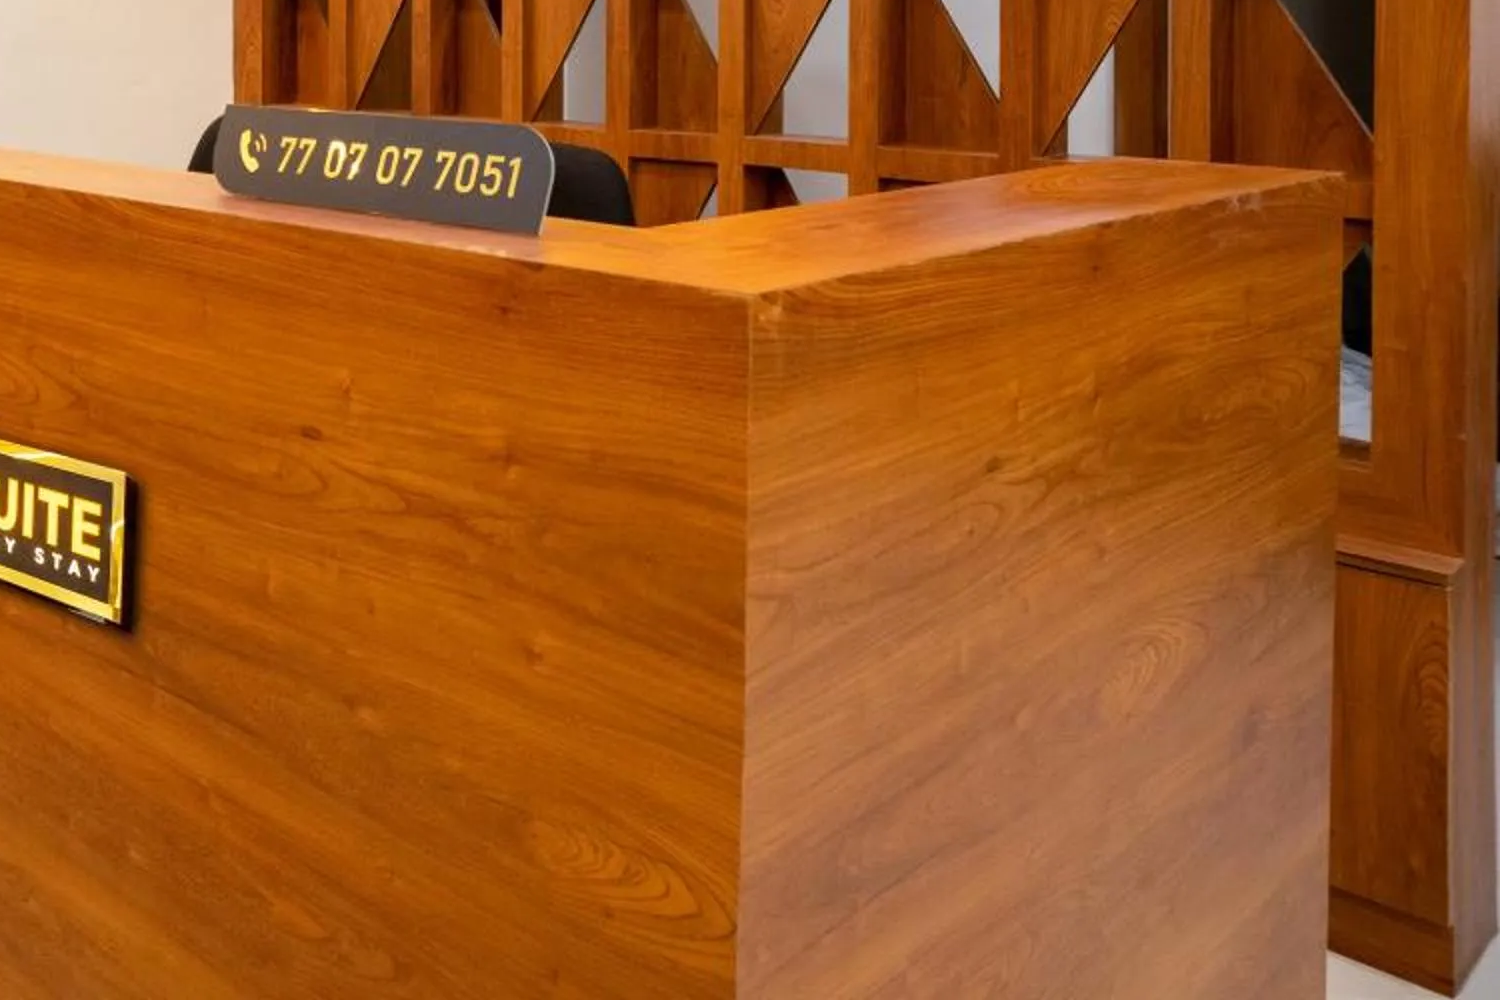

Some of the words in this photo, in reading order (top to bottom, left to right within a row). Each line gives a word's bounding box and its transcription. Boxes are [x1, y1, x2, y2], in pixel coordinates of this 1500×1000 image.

[277, 136, 317, 175] 77
[323, 140, 368, 181] 07
[375, 145, 423, 188] 07
[434, 151, 523, 199] 7051
[33, 547, 100, 584] STAY
